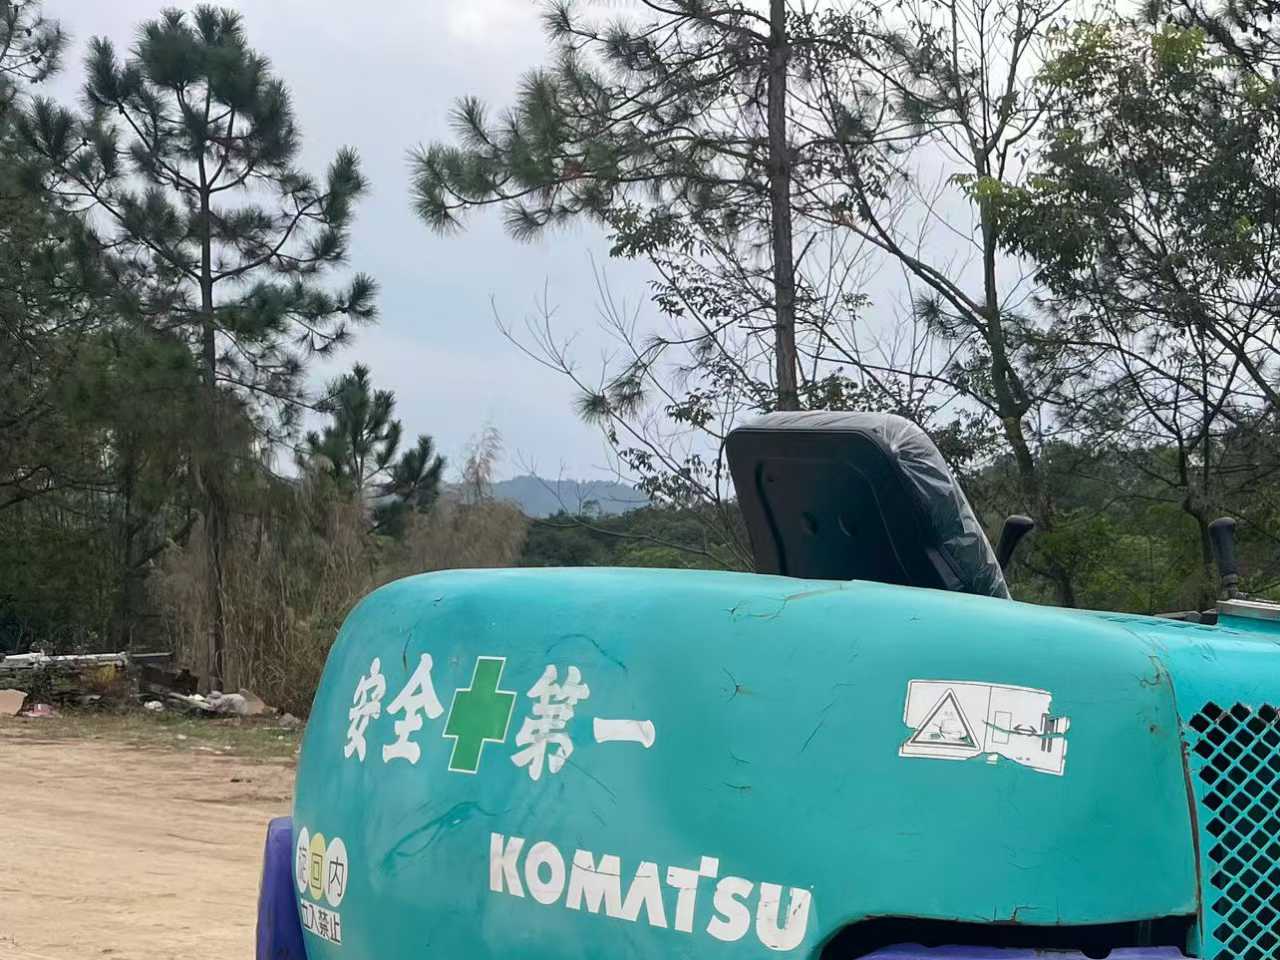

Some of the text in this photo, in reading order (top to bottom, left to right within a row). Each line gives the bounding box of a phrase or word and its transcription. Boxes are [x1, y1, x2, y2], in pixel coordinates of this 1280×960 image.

[344, 653, 656, 781] 安全 第一
[489, 832, 813, 951] KOMATSU
